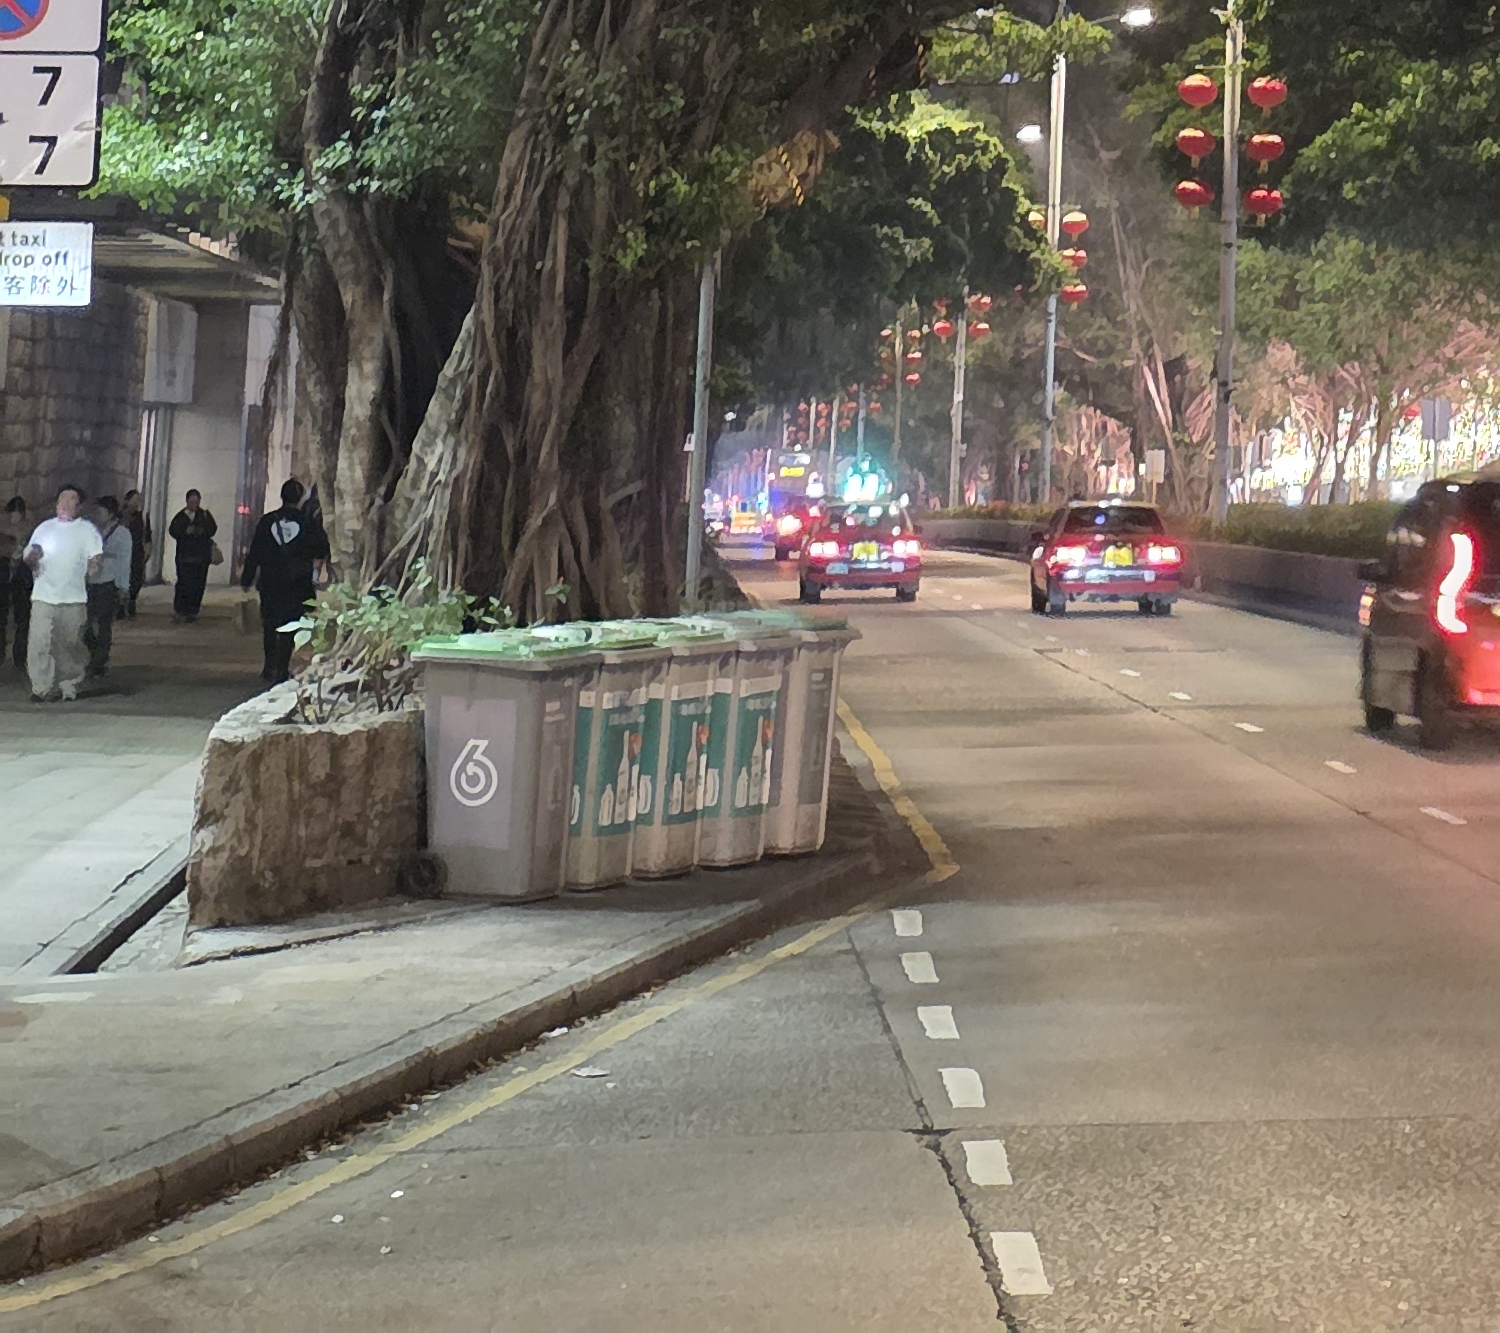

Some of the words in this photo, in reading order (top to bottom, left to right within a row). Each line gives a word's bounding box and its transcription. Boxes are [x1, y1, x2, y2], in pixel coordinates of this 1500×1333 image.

[32, 65, 62, 106] 7
[28, 134, 58, 175] 7
[11, 228, 47, 247] taxi
[42, 250, 69, 267] off
[4, 275, 78, 296] 客除外
[449, 738, 498, 807] 6
